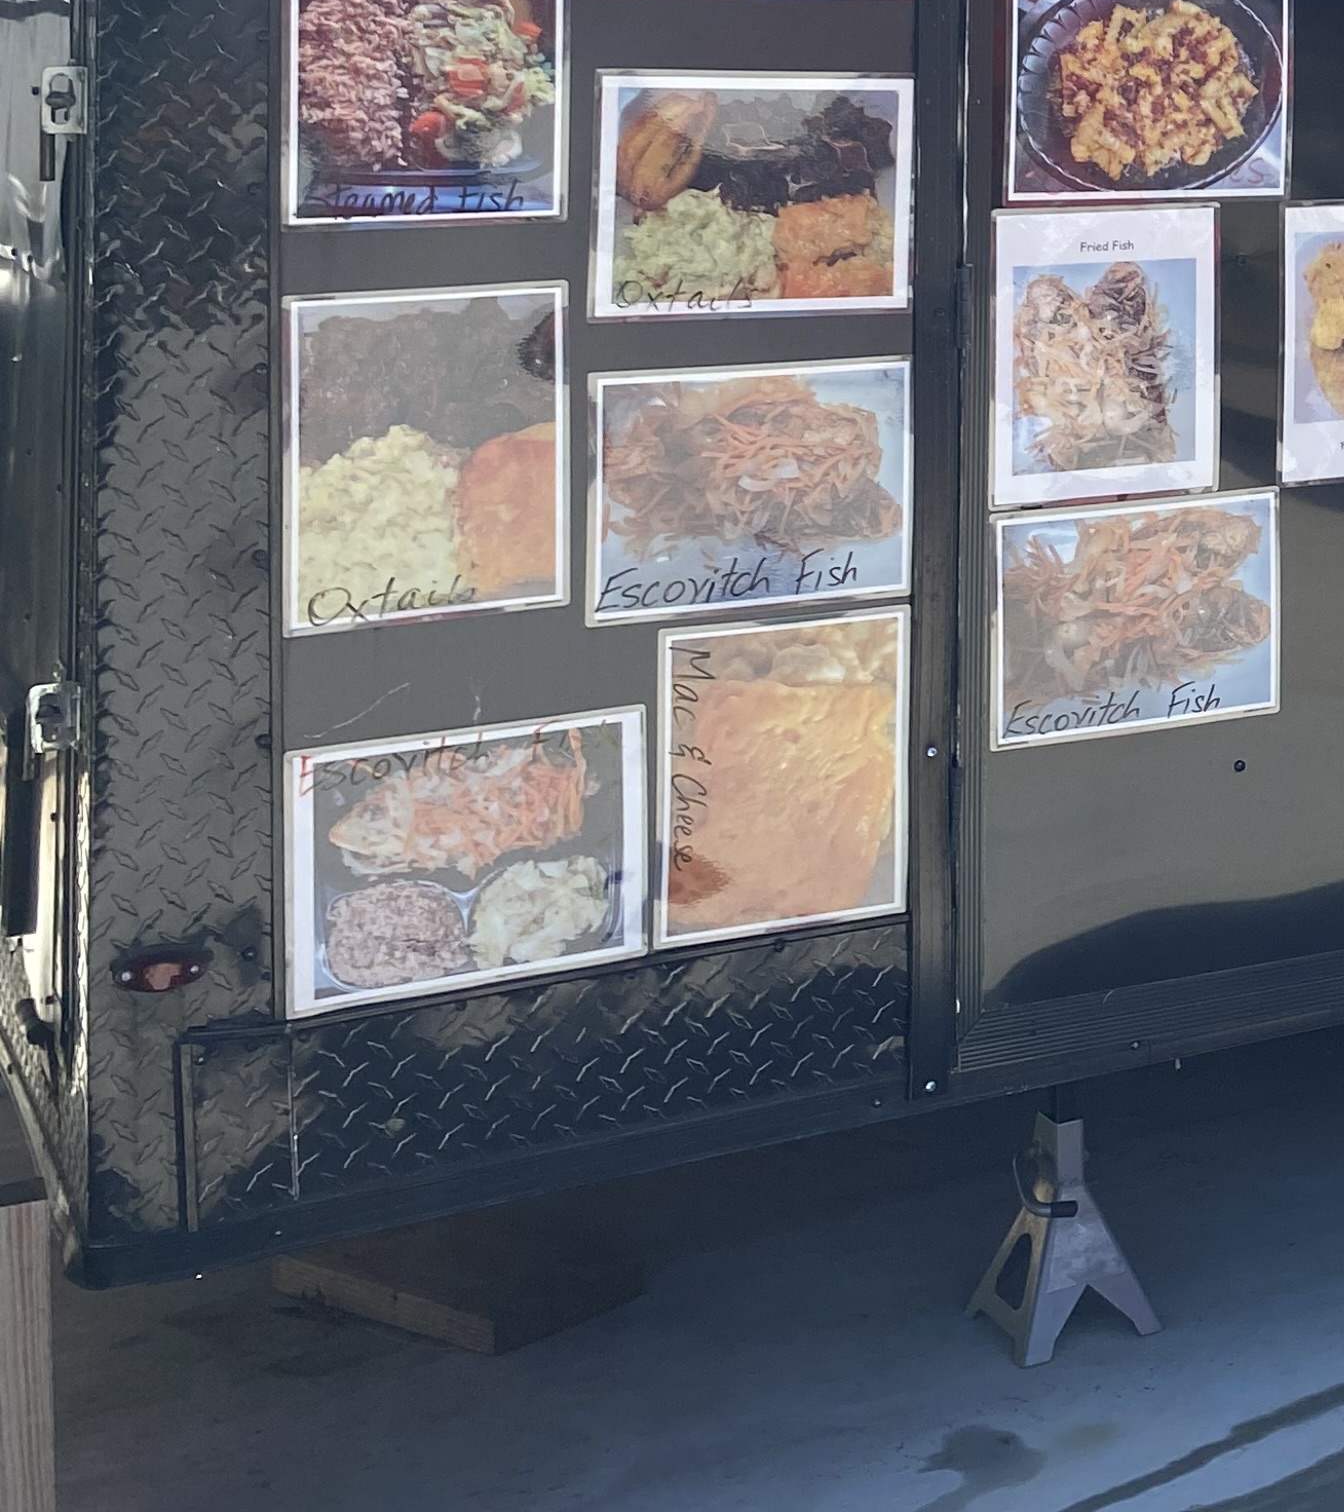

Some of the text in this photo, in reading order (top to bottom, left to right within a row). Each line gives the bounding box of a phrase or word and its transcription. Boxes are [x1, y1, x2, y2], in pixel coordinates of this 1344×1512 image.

[1080, 239, 1135, 253] Fried Fish
[597, 548, 859, 614] Escovitch Fish
[1002, 681, 1222, 739] Escovitch Fish
[667, 645, 713, 876] Mac Cheese
